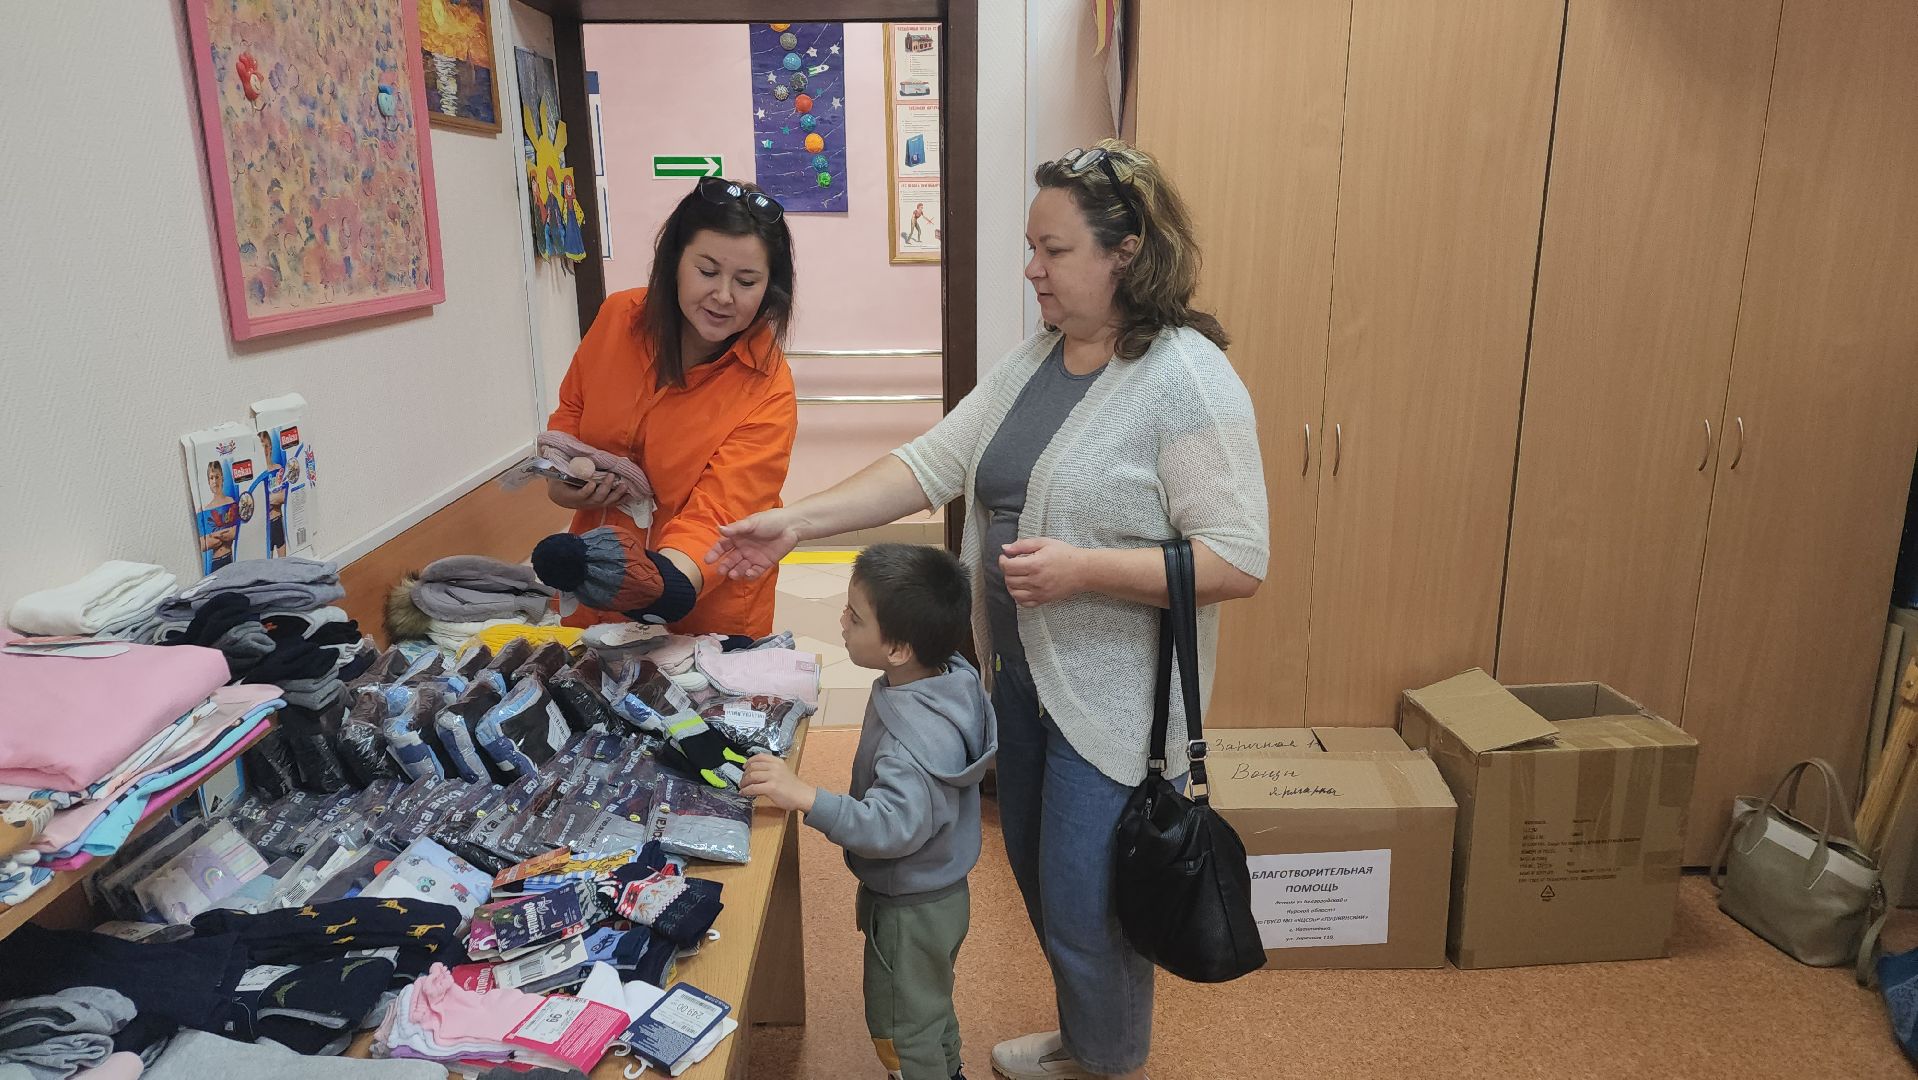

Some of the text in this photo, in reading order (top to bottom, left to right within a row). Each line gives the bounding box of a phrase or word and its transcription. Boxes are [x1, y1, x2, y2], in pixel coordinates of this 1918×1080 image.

[1251, 866, 1374, 880] БЛАГОТВОРИТЕЛЬНАЯ
[1285, 883, 1339, 893] ПОМОЩЬ
[476, 967, 492, 995] UTURINO
